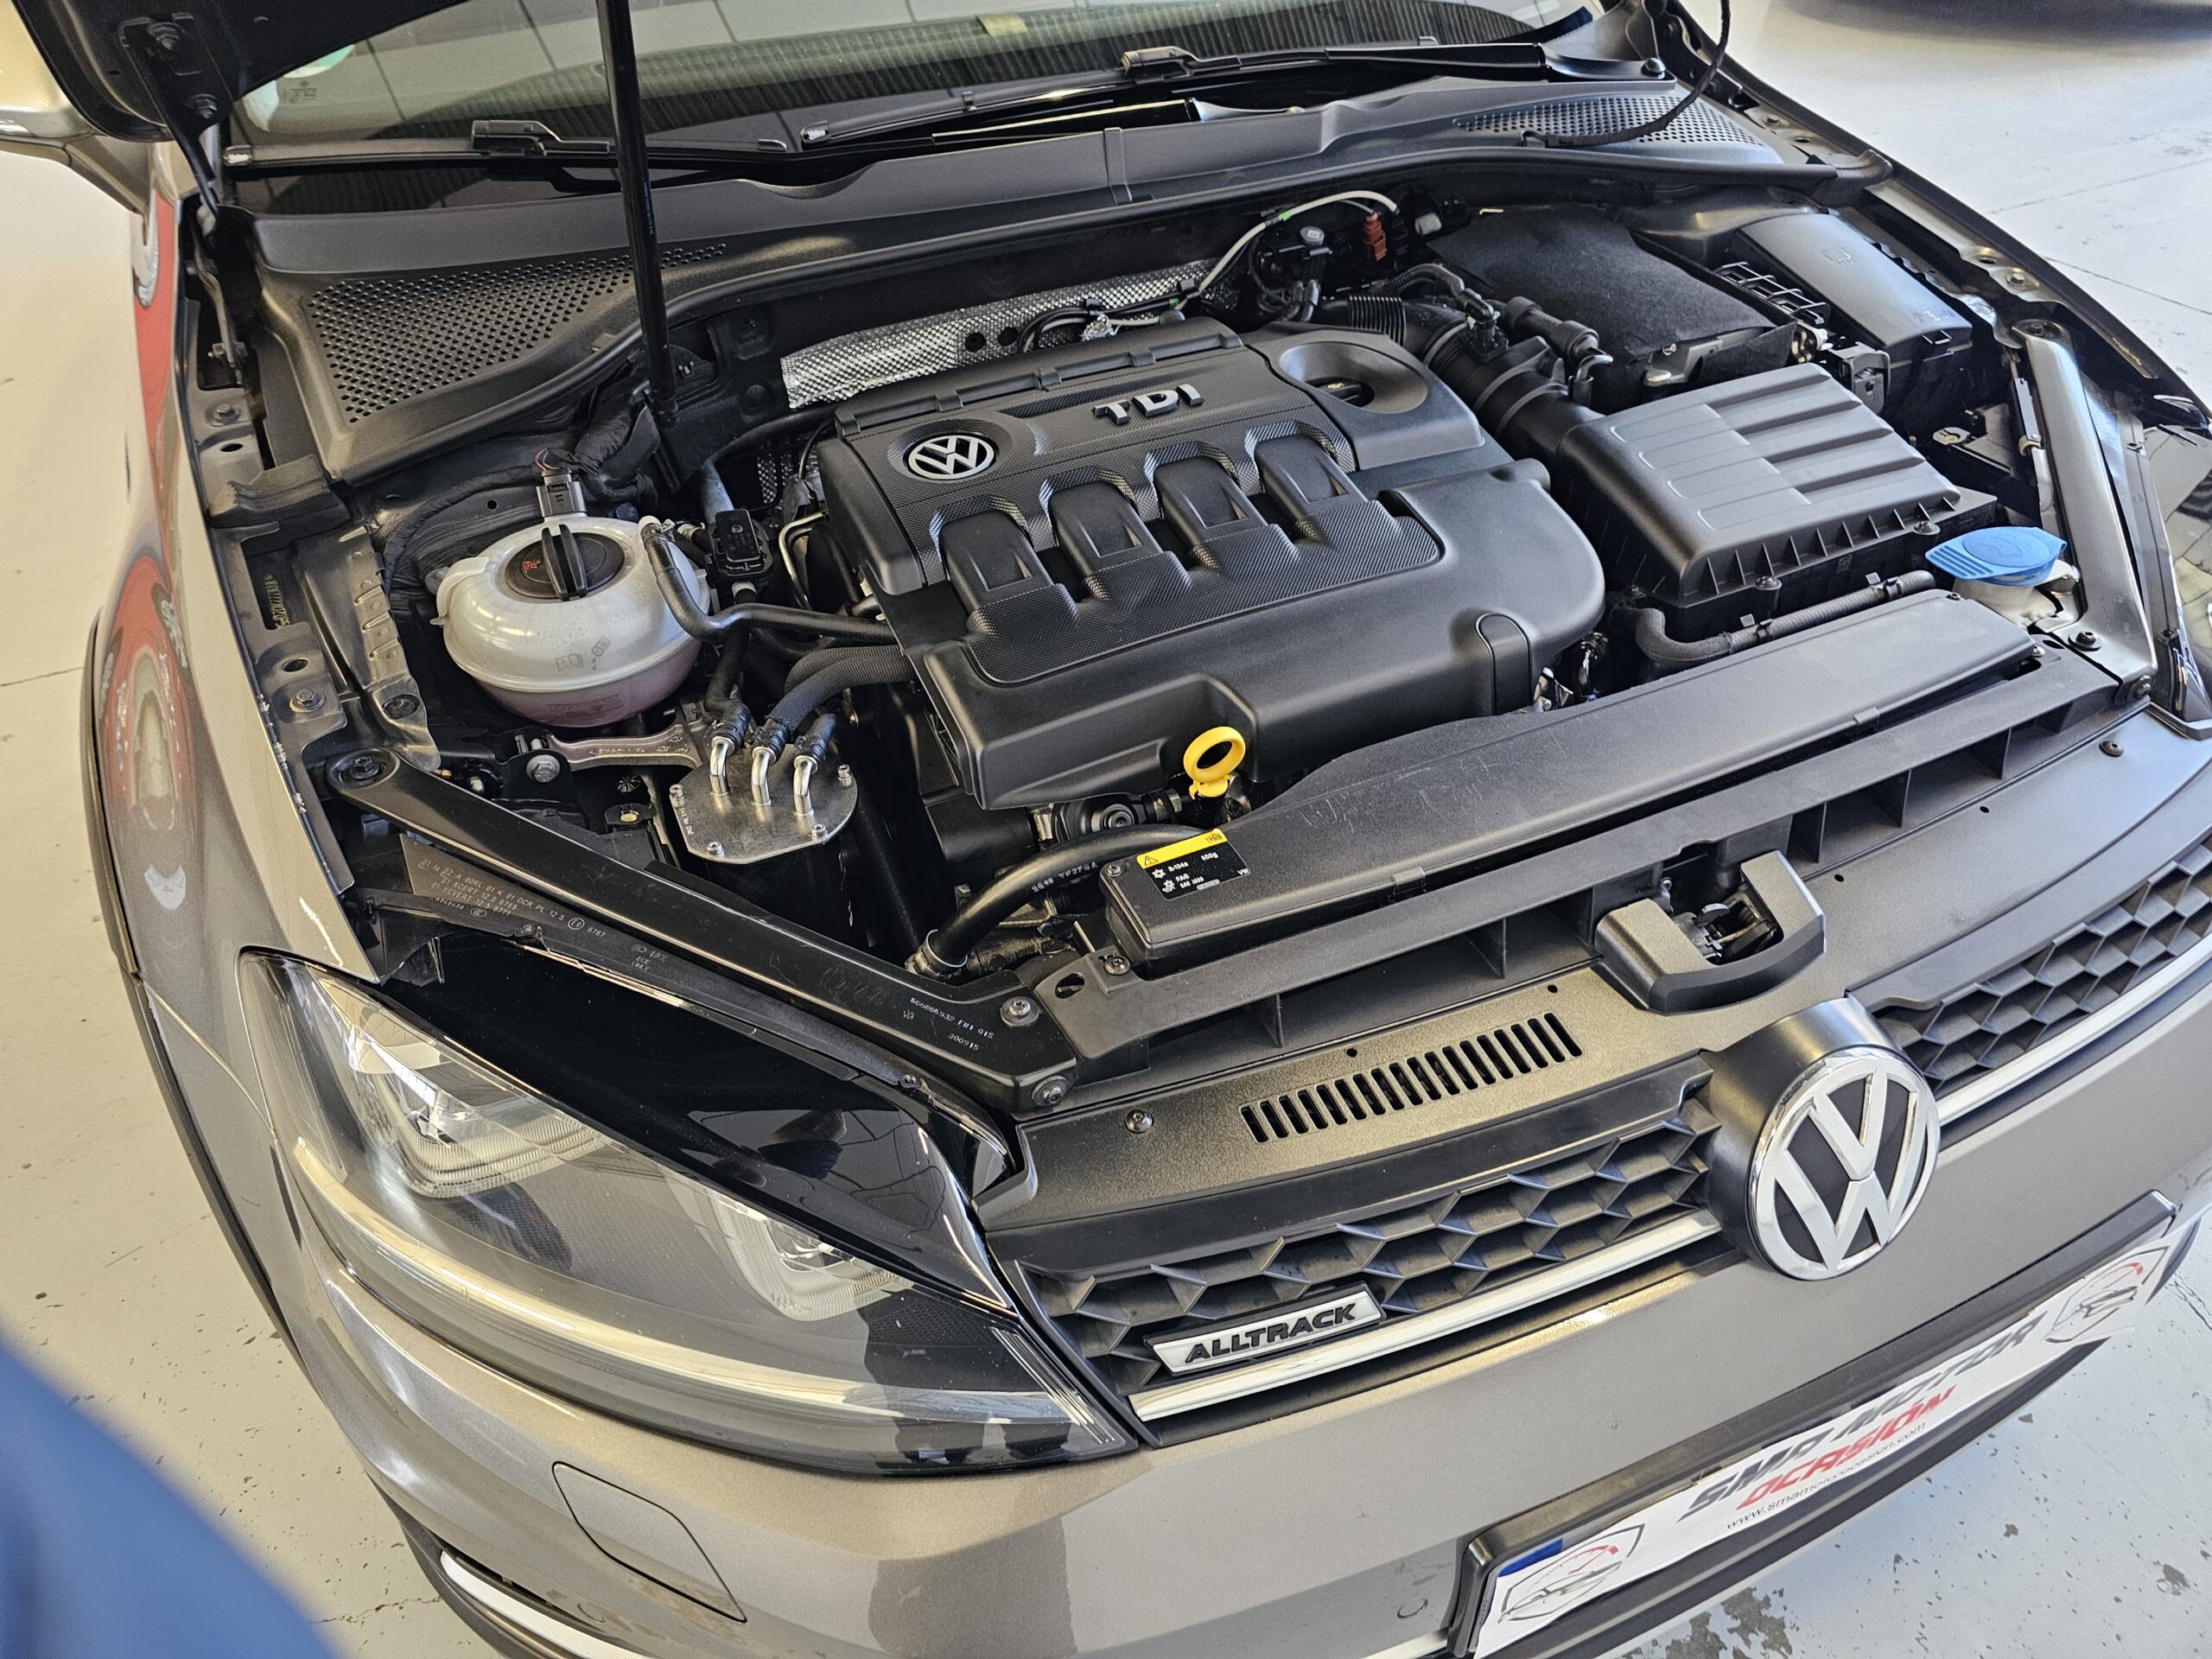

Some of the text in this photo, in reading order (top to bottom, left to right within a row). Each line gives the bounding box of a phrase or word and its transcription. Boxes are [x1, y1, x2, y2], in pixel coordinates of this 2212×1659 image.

[1091, 383, 1205, 425] TDI
[1185, 1302, 1356, 1363] ALLTRACK
[1736, 1383, 1957, 1510] OCASIÓN
